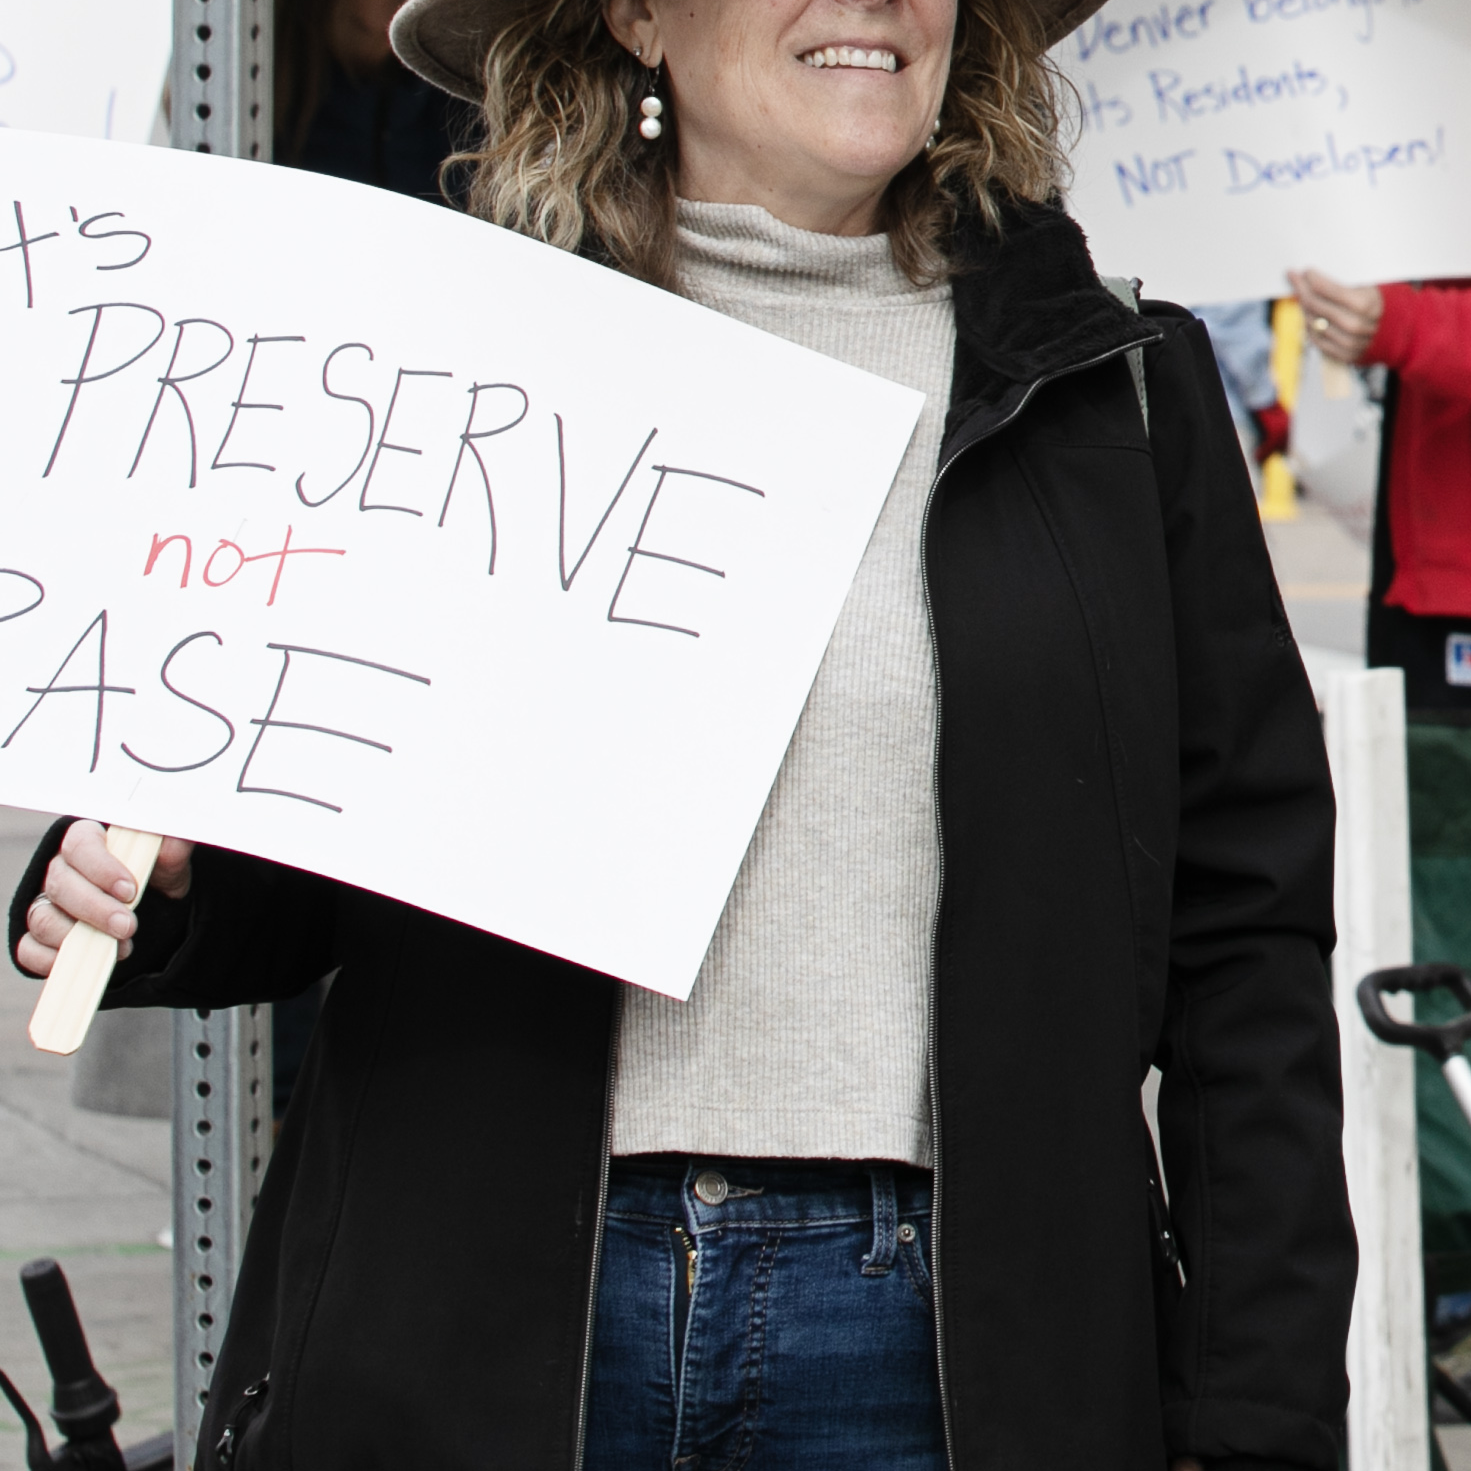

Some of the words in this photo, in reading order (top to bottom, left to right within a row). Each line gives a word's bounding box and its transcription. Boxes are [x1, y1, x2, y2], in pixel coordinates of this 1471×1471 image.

[1076, 0, 1216, 61] Denver
[1148, 61, 1349, 126] Residents,
[1113, 148, 1197, 208] NOT
[42, 302, 765, 638] PRESERVE
[143, 524, 347, 608] not
